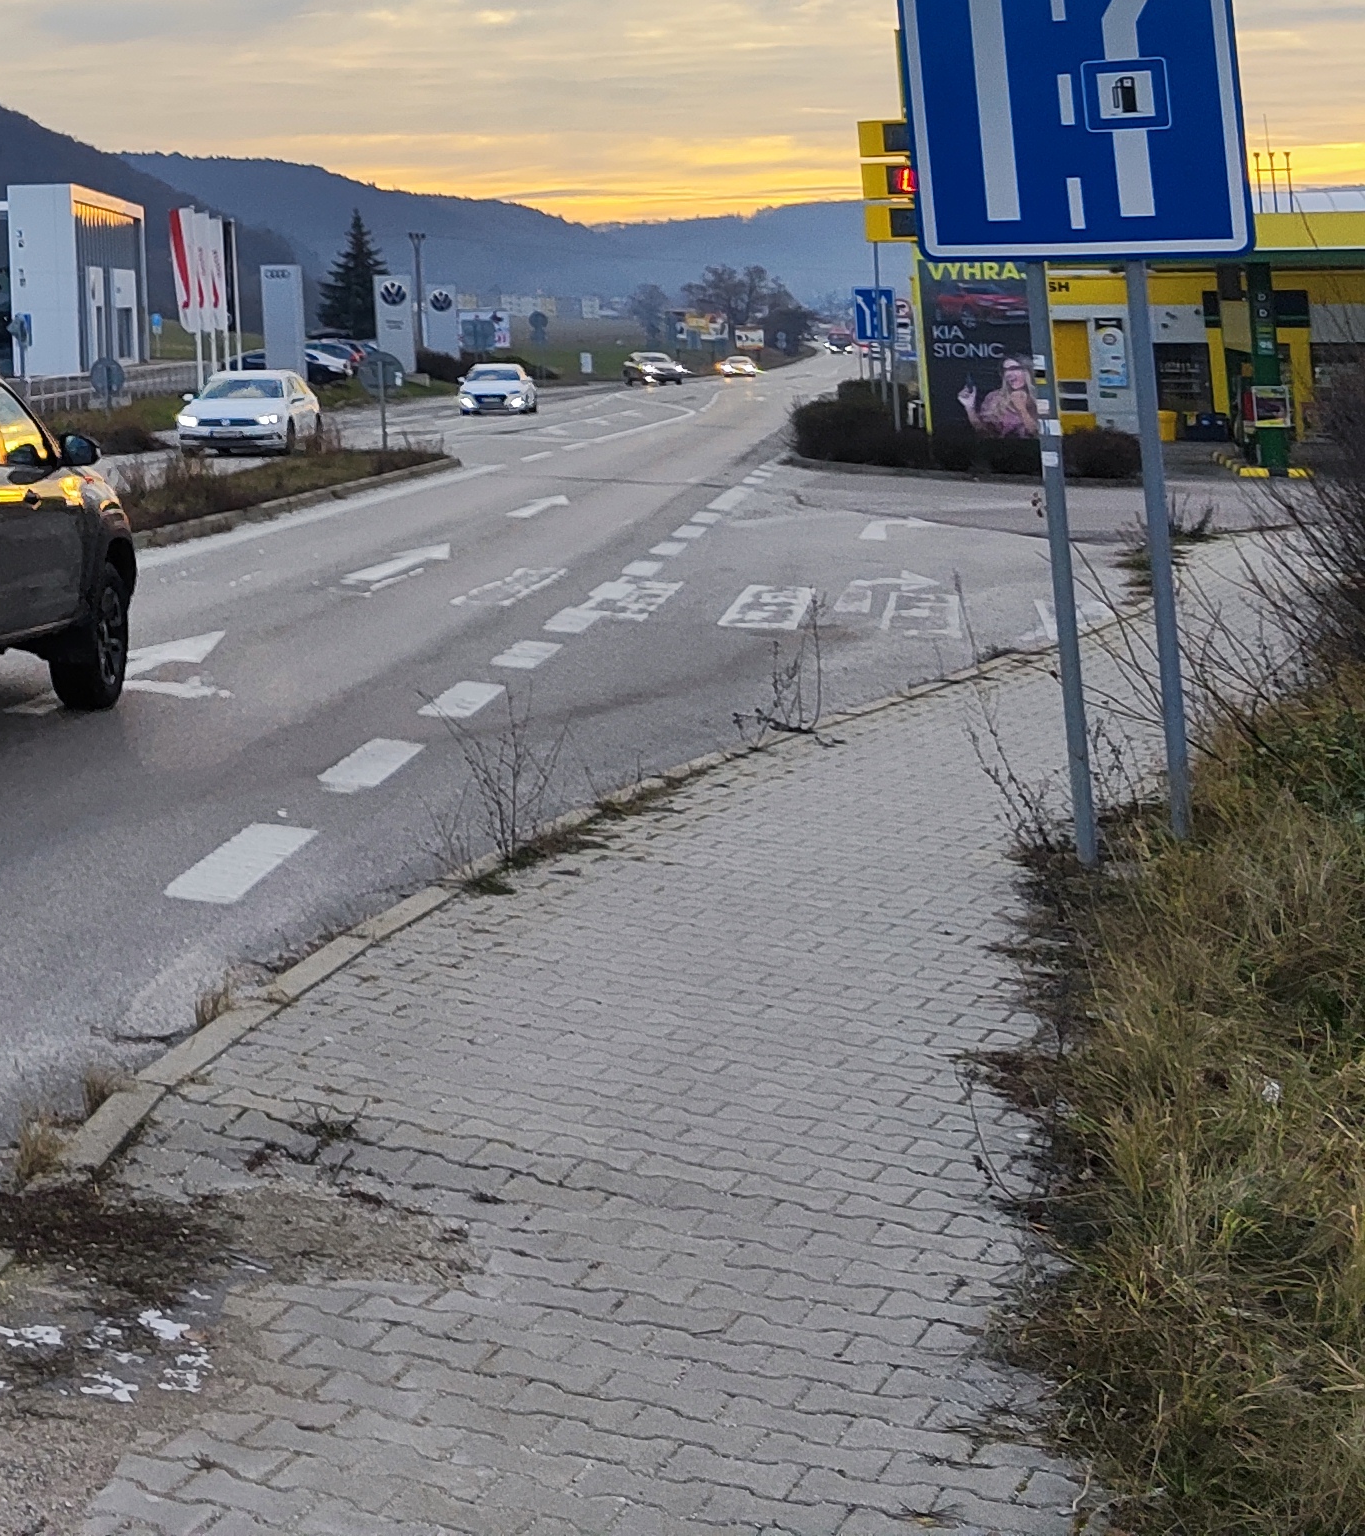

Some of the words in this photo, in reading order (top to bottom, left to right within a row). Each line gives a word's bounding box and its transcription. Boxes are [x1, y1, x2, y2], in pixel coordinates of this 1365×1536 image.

[926, 262, 1027, 280] VYHRA.
[931, 325, 965, 341] KIA
[933, 343, 1005, 359] STONIC
